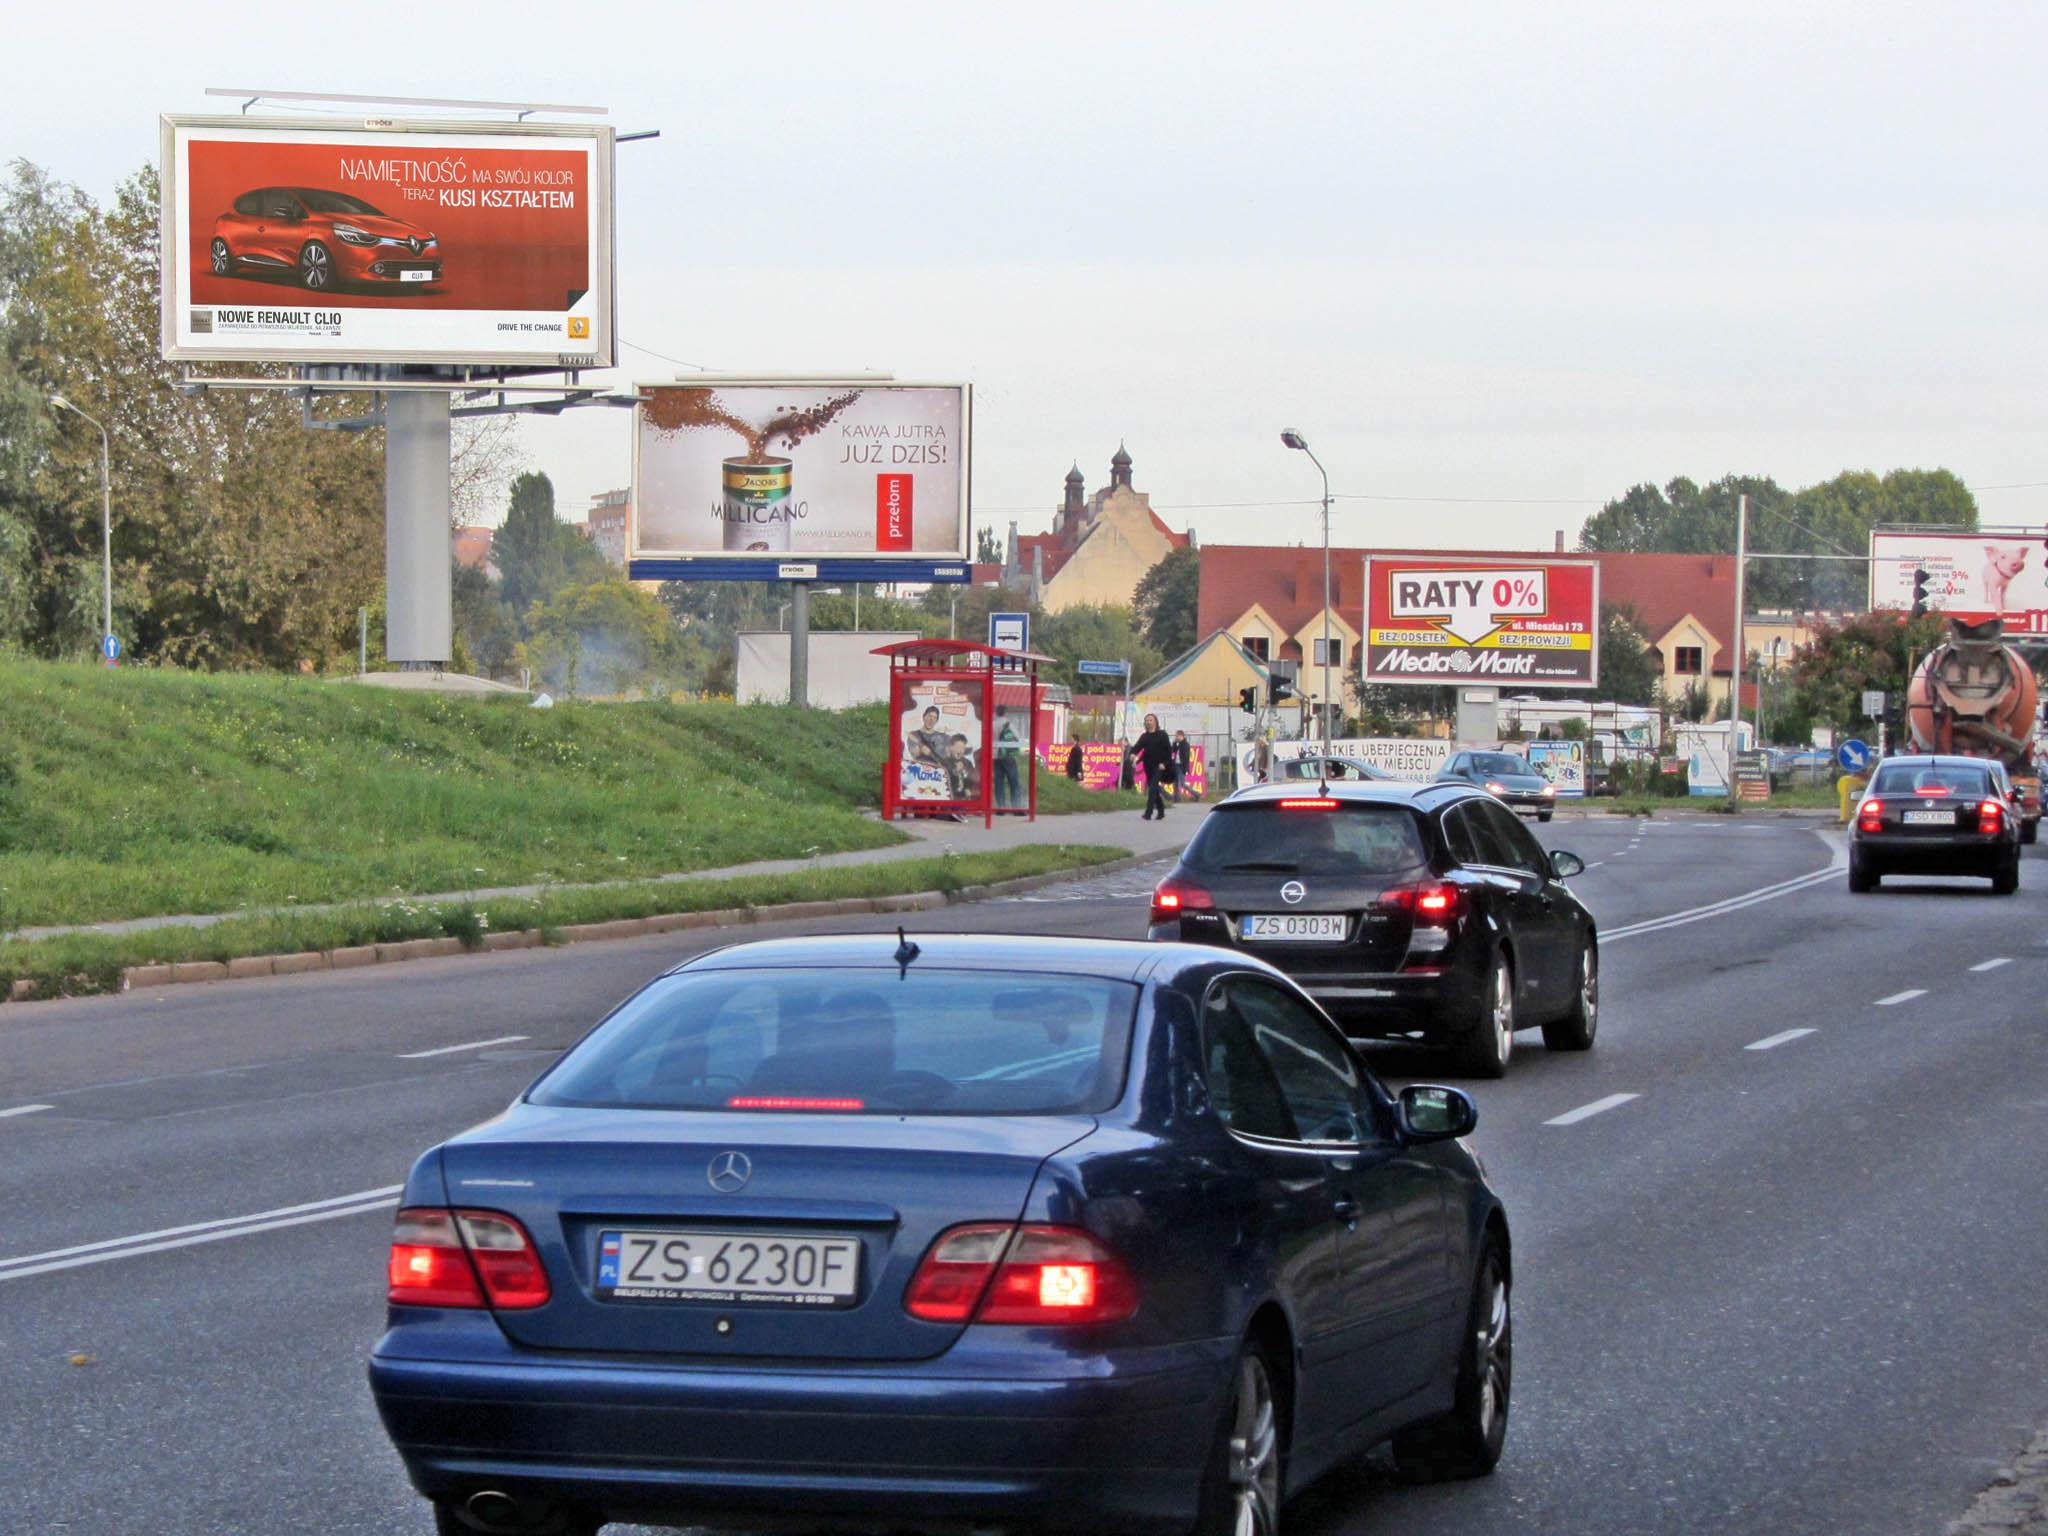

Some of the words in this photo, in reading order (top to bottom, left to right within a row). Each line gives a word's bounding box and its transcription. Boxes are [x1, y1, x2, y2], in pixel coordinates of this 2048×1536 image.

[340, 156, 466, 187] NAMIĘTNOŚĆ
[472, 169, 492, 184] MA
[495, 167, 530, 185] SWÓJ
[534, 170, 573, 185] KOLOR
[402, 187, 435, 201] TERAZ
[439, 189, 476, 207] KUSI
[481, 190, 574, 208] KSZTAŁTEM
[218, 310, 254, 323] NOWE
[258, 311, 311, 325] RENAULT
[314, 312, 341, 325] CLIO
[497, 323, 518, 331] DRIVE
[520, 323, 533, 331] THE
[534, 324, 562, 332] CHANGE
[841, 425, 890, 438] KAWA
[894, 425, 946, 438] JUTRA
[840, 440, 883, 463] JUŻ
[892, 440, 947, 464] DZIŚ!
[710, 501, 809, 524] MILLICANO
[887, 480, 902, 538] przełom
[1952, 570, 1968, 580] 9%
[1399, 580, 1484, 608] RATY
[1493, 579, 1538, 607] 0%
[1512, 621, 1524, 630] ul.
[1526, 621, 1563, 631] Mieszka
[1571, 622, 1583, 631] 73
[1378, 631, 1398, 642] BEZ
[1400, 632, 1447, 643] ODSETEK
[1499, 634, 1520, 644] BEZ
[1521, 635, 1571, 646] PROWIZJI
[1087, 745, 1104, 755] pod
[1362, 743, 1446, 757] UBEZPIECZENIA
[1384, 758, 1431, 770] MIEJSCU
[1255, 918, 1280, 934] ZS
[1287, 918, 1343, 935] 0303W
[627, 1239, 690, 1283] ZS
[708, 1241, 848, 1288] 6230F
[601, 1264, 617, 1278] PL
